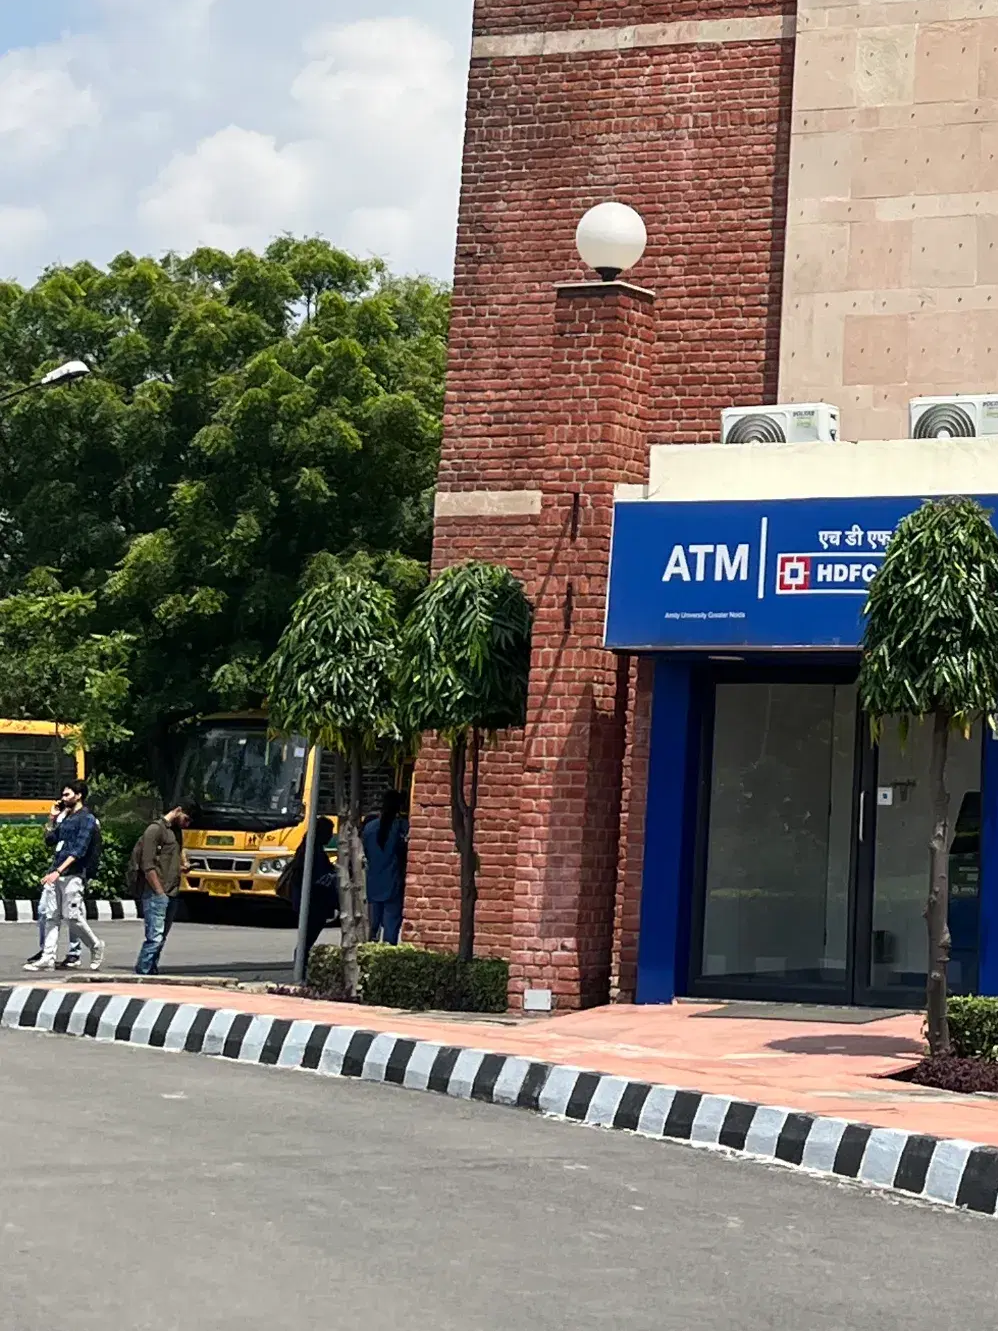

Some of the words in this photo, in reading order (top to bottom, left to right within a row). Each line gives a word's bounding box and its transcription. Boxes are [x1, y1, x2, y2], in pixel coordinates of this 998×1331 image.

[818, 530, 842, 550] एच
[844, 524, 864, 547] डी
[661, 543, 749, 582] ATM
[817, 563, 878, 582] HDFC
